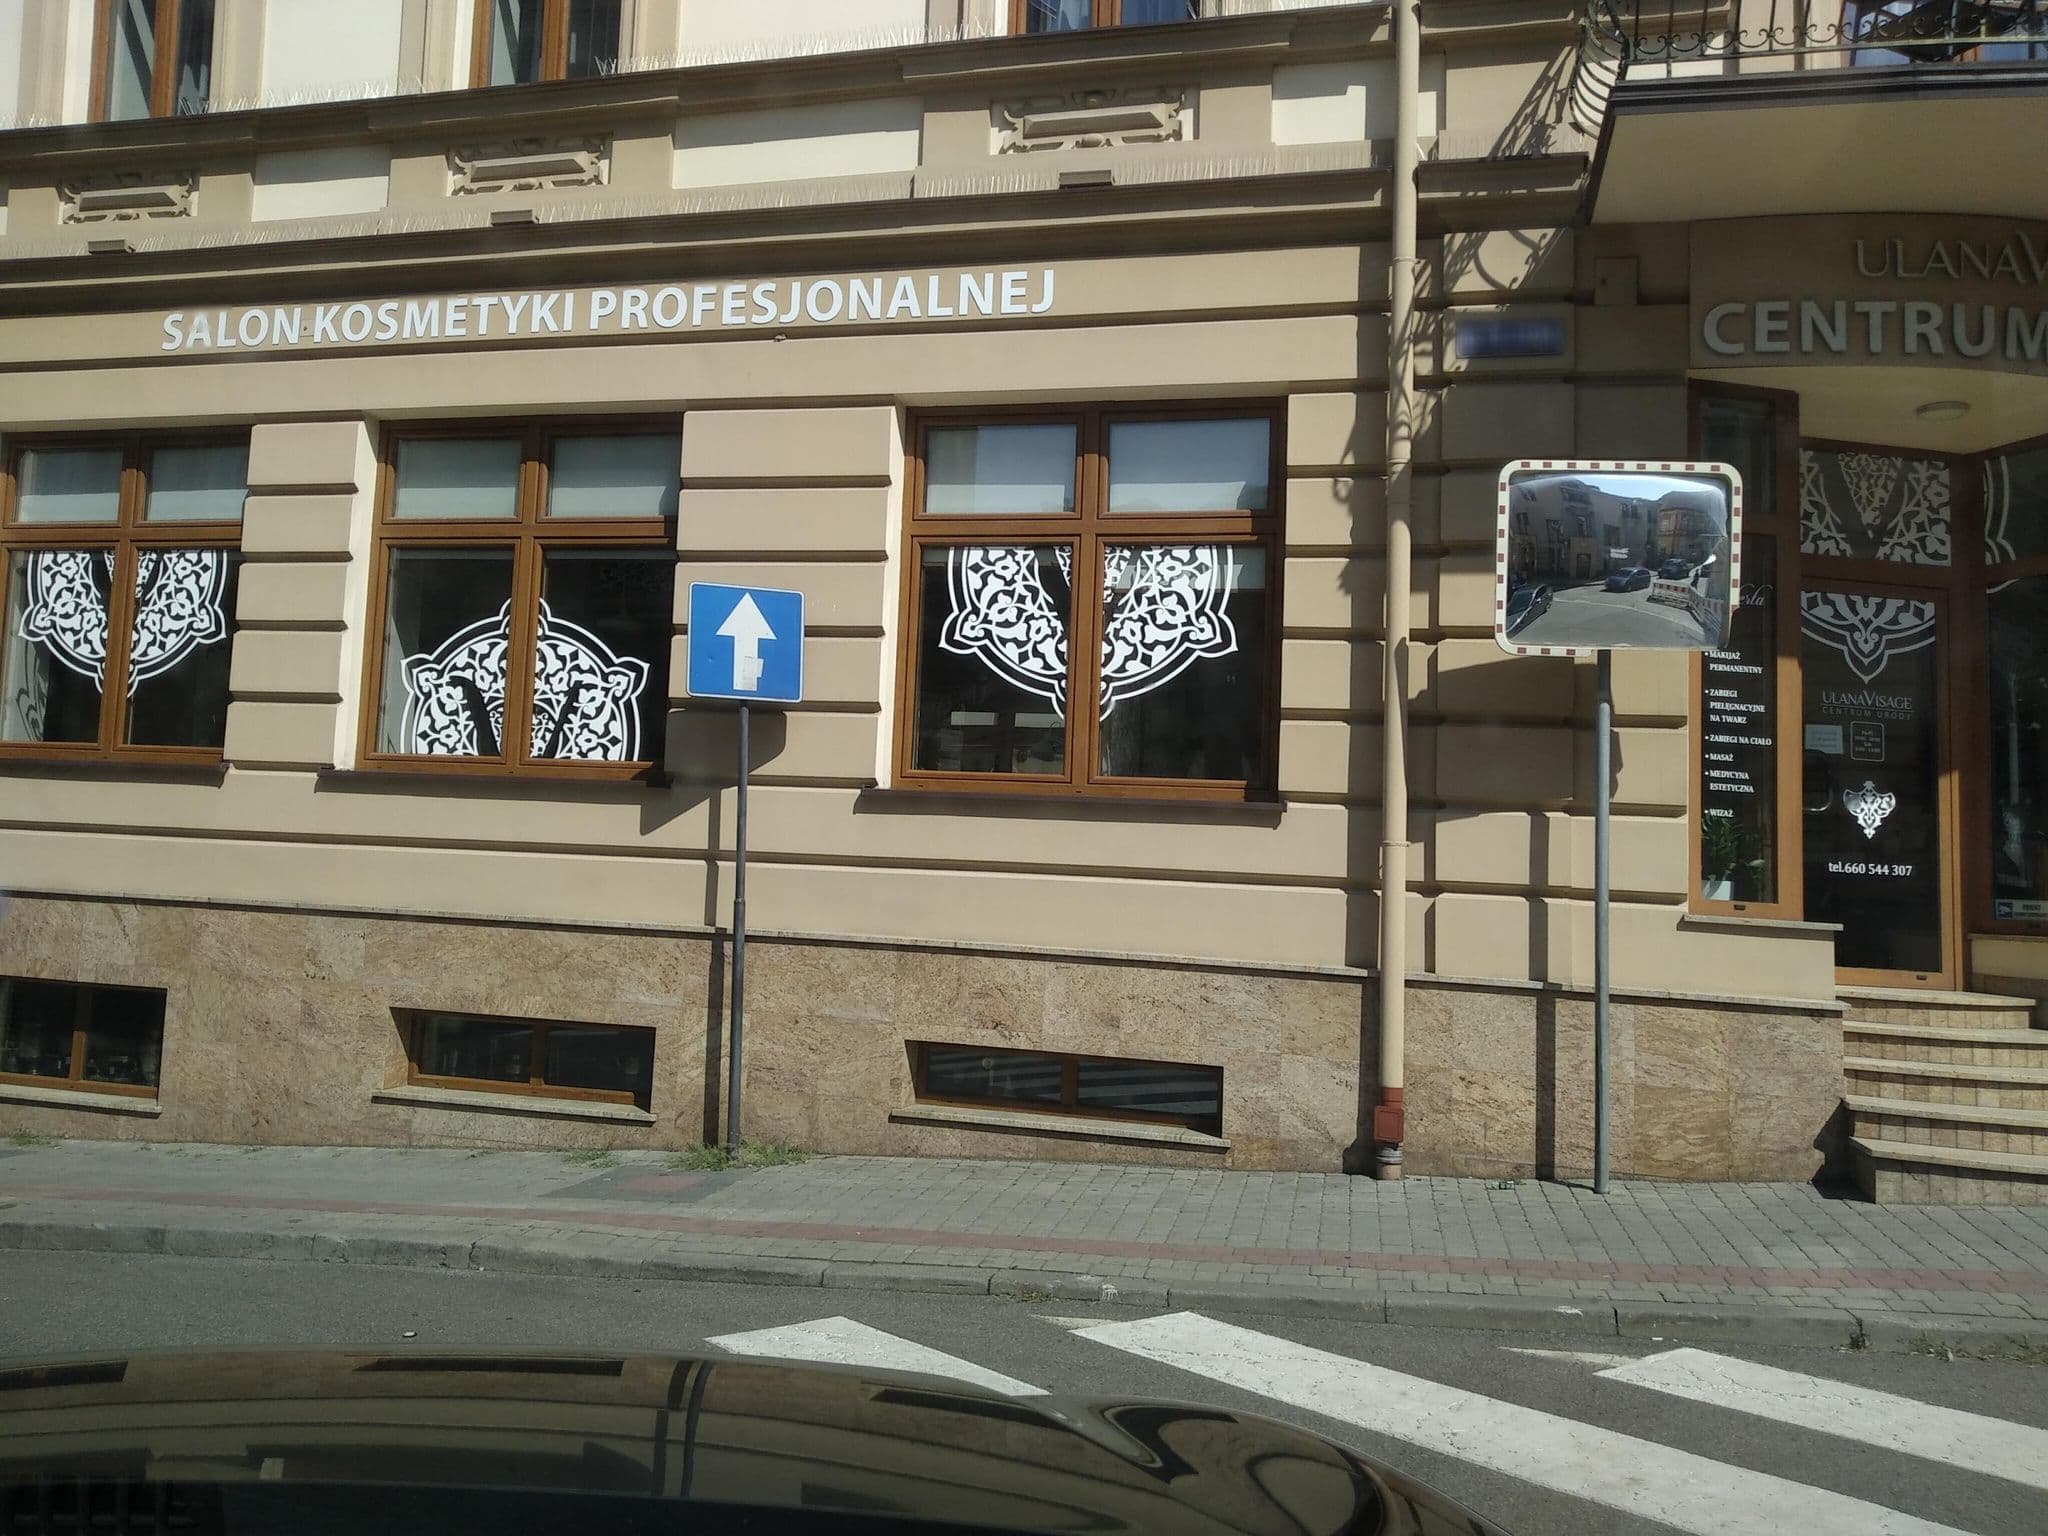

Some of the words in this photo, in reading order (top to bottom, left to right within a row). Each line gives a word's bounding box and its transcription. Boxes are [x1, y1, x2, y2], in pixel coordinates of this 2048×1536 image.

[162, 304, 302, 351] SALON
[312, 292, 575, 344] KOSMETYKI
[590, 269, 1055, 330] PROFESJONALNEJ
[1702, 298, 2048, 361] CENTRUM
[1710, 664, 1763, 674] PERMANENTNY
[1710, 688, 1738, 698] ZABIEGI
[1710, 715, 1720, 724] NA
[1722, 715, 1748, 725] TWARZ
[1710, 735, 1738, 744] ZABIEGI
[1739, 736, 1750, 745] NA
[1710, 770, 1749, 780] MEDYCYNA
[1710, 783, 1754, 793] ESTETYCZNA
[1868, 864, 1890, 876] 544
[1891, 865, 1912, 877] 307
